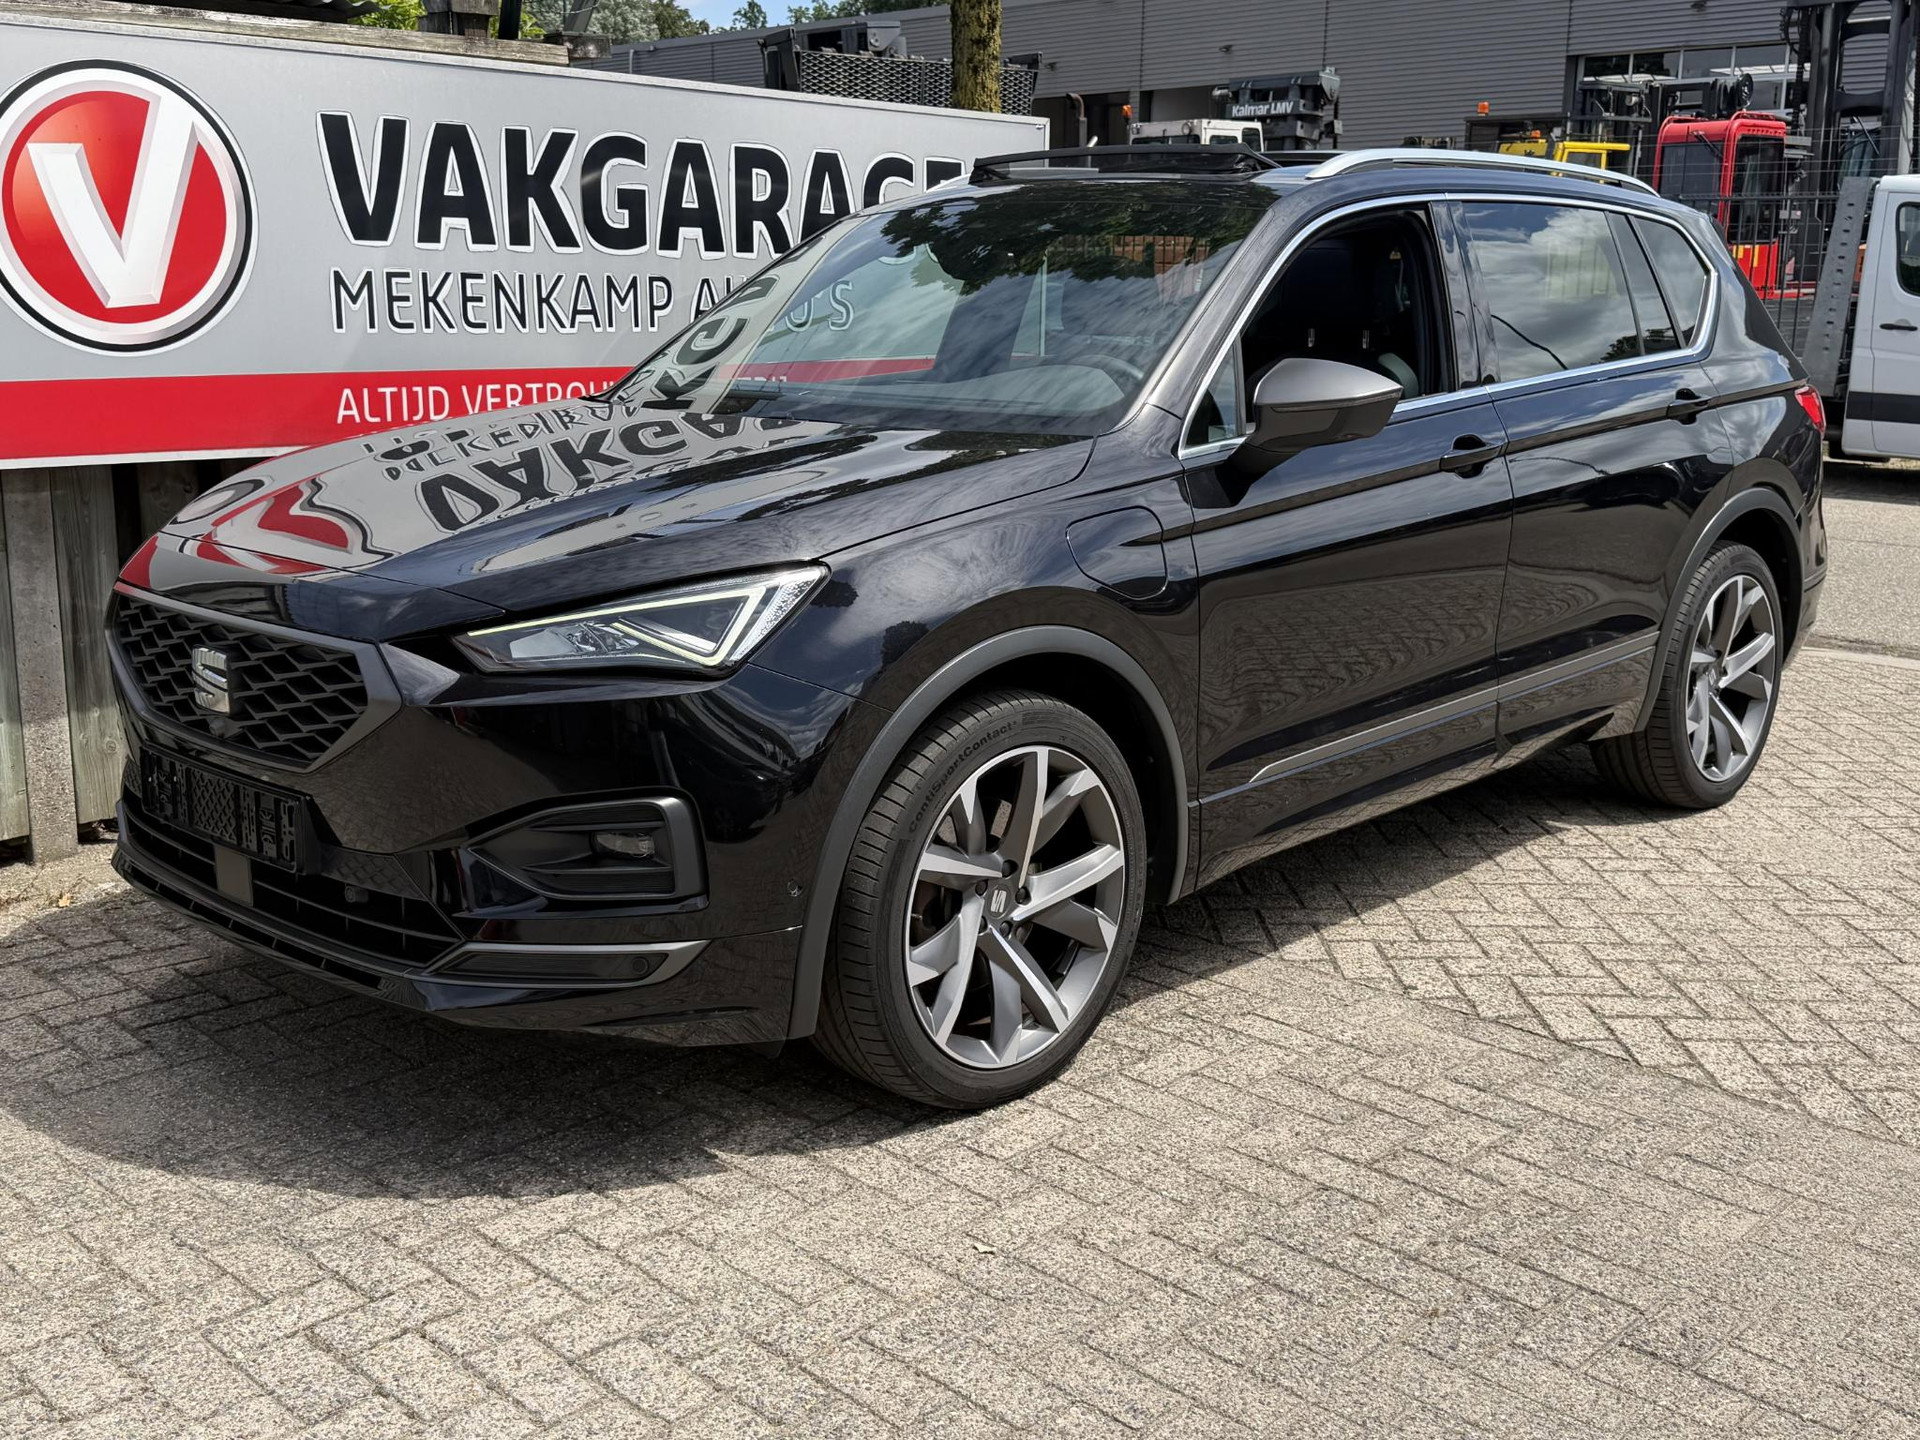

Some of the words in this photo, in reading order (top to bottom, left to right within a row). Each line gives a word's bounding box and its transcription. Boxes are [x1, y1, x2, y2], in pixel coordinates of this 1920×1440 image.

[1231, 103, 1270, 117] Kalmar
[1270, 101, 1294, 115] LMV
[332, 268, 673, 332] MEKENKAMP
[336, 385, 450, 424] ALTIJD
